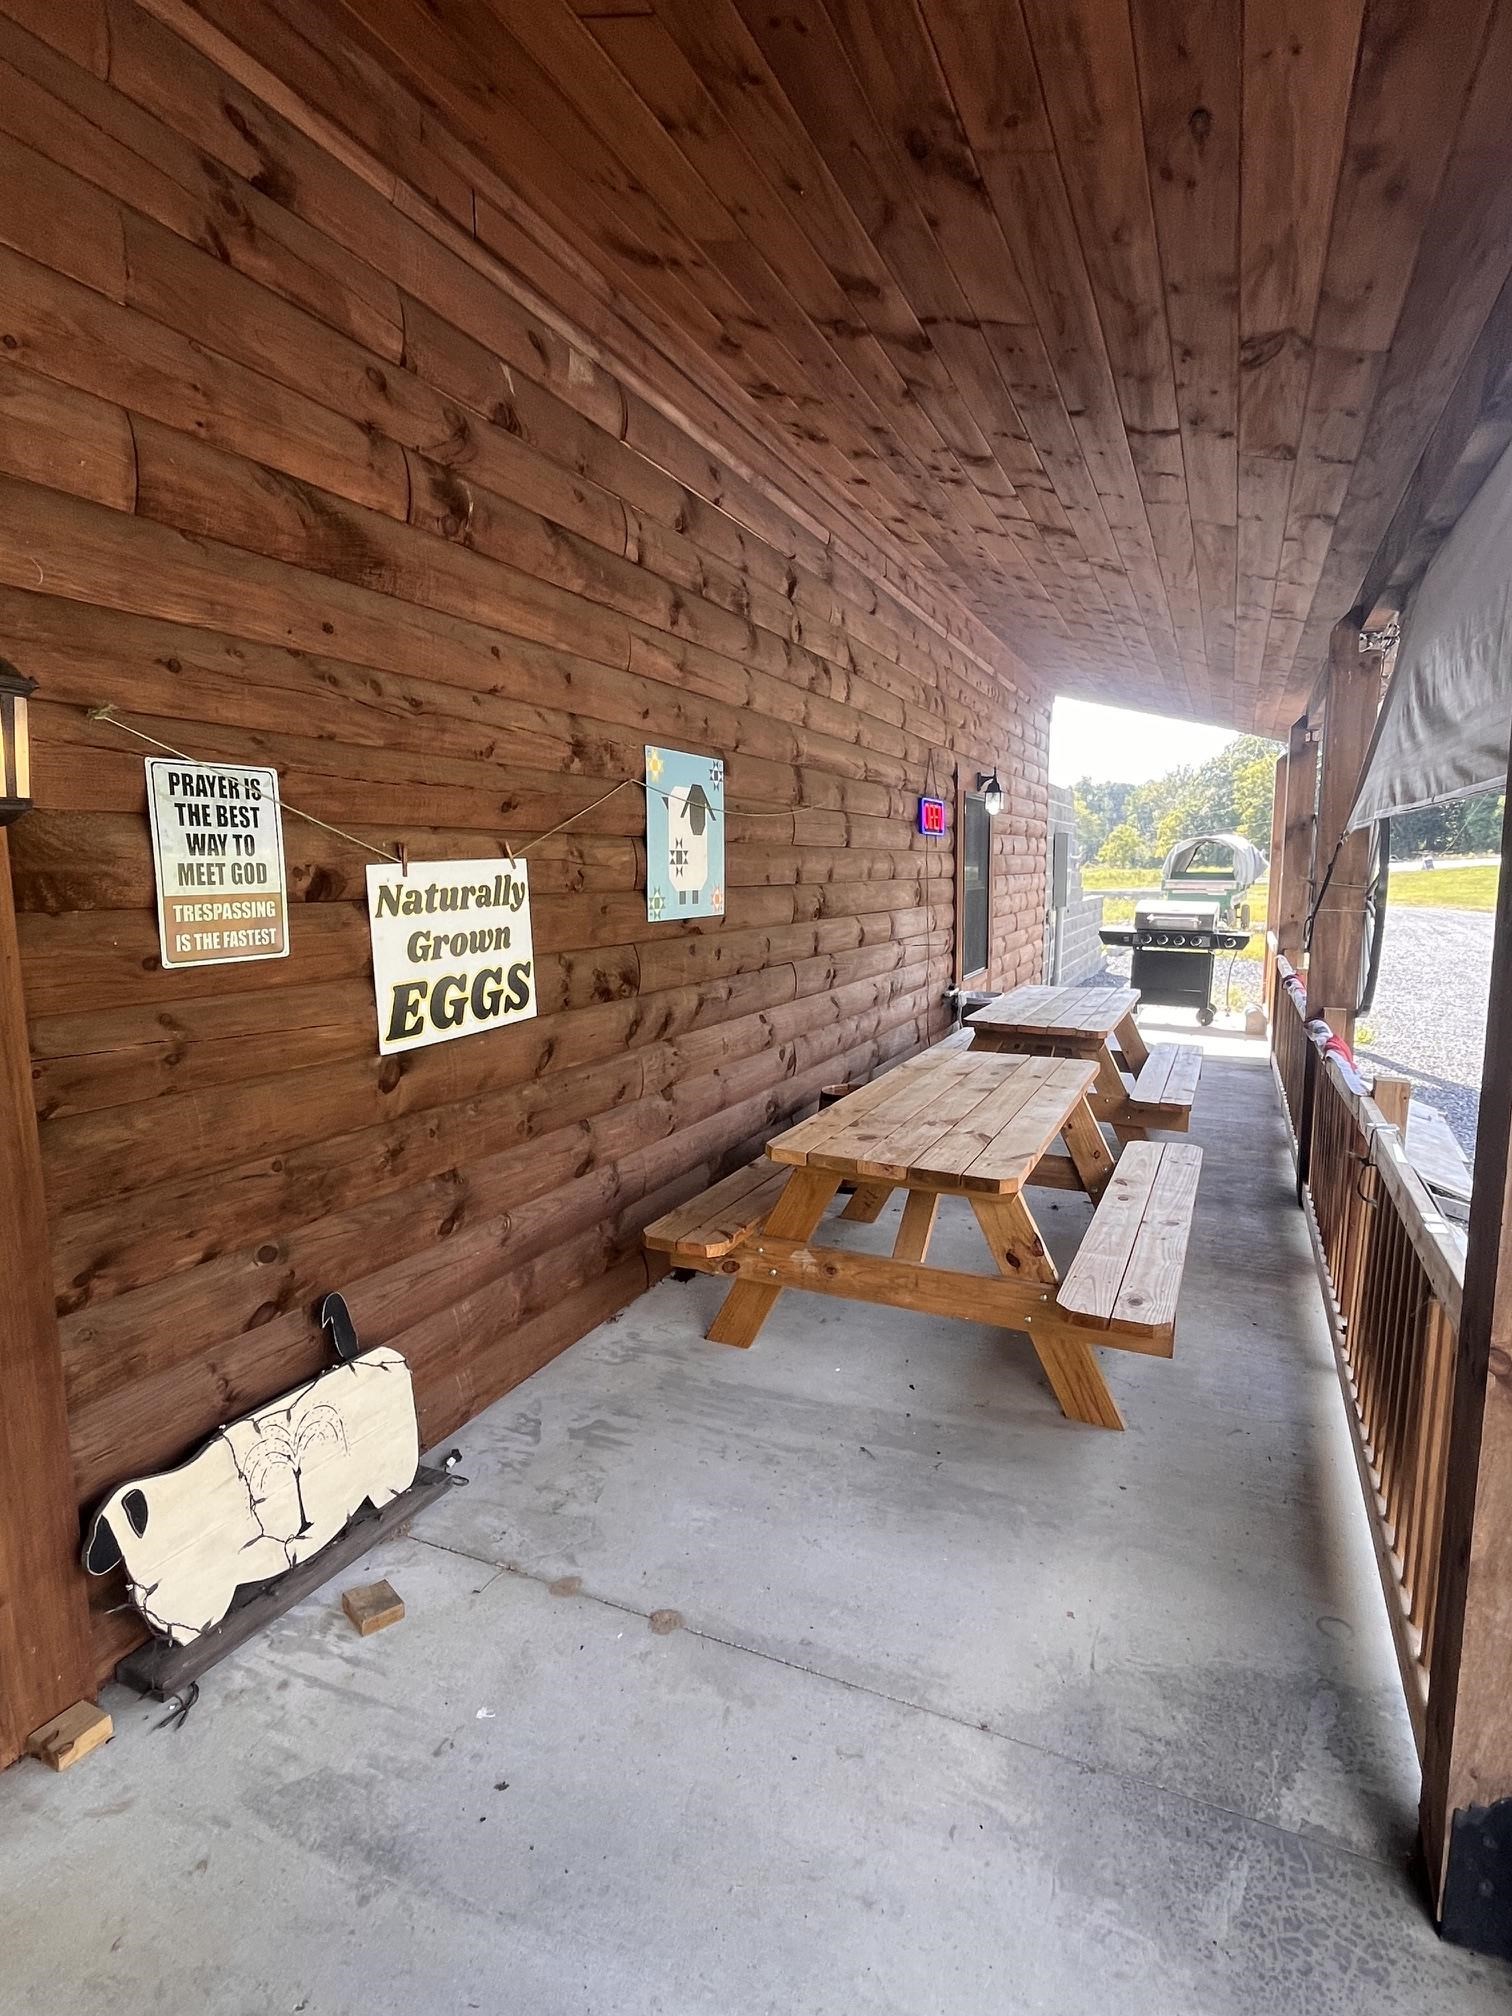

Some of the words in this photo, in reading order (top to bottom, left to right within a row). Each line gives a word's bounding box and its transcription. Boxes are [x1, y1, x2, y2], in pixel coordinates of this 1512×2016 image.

[168, 771, 240, 799] PRAYER
[244, 777, 262, 801] IS
[174, 802, 212, 827] THE
[216, 804, 260, 829] BEST
[185, 833, 228, 856] WAY
[232, 834, 256, 857] TO
[177, 862, 226, 887] MEET
[231, 862, 268, 885] GOD
[375, 874, 526, 918] Naturally
[172, 900, 276, 923] TRESPASSING
[175, 933, 192, 952] IS
[193, 931, 221, 951] THE
[222, 927, 277, 949] FASTEST
[407, 926, 511, 963] Grown
[385, 961, 532, 1042] EGGS
